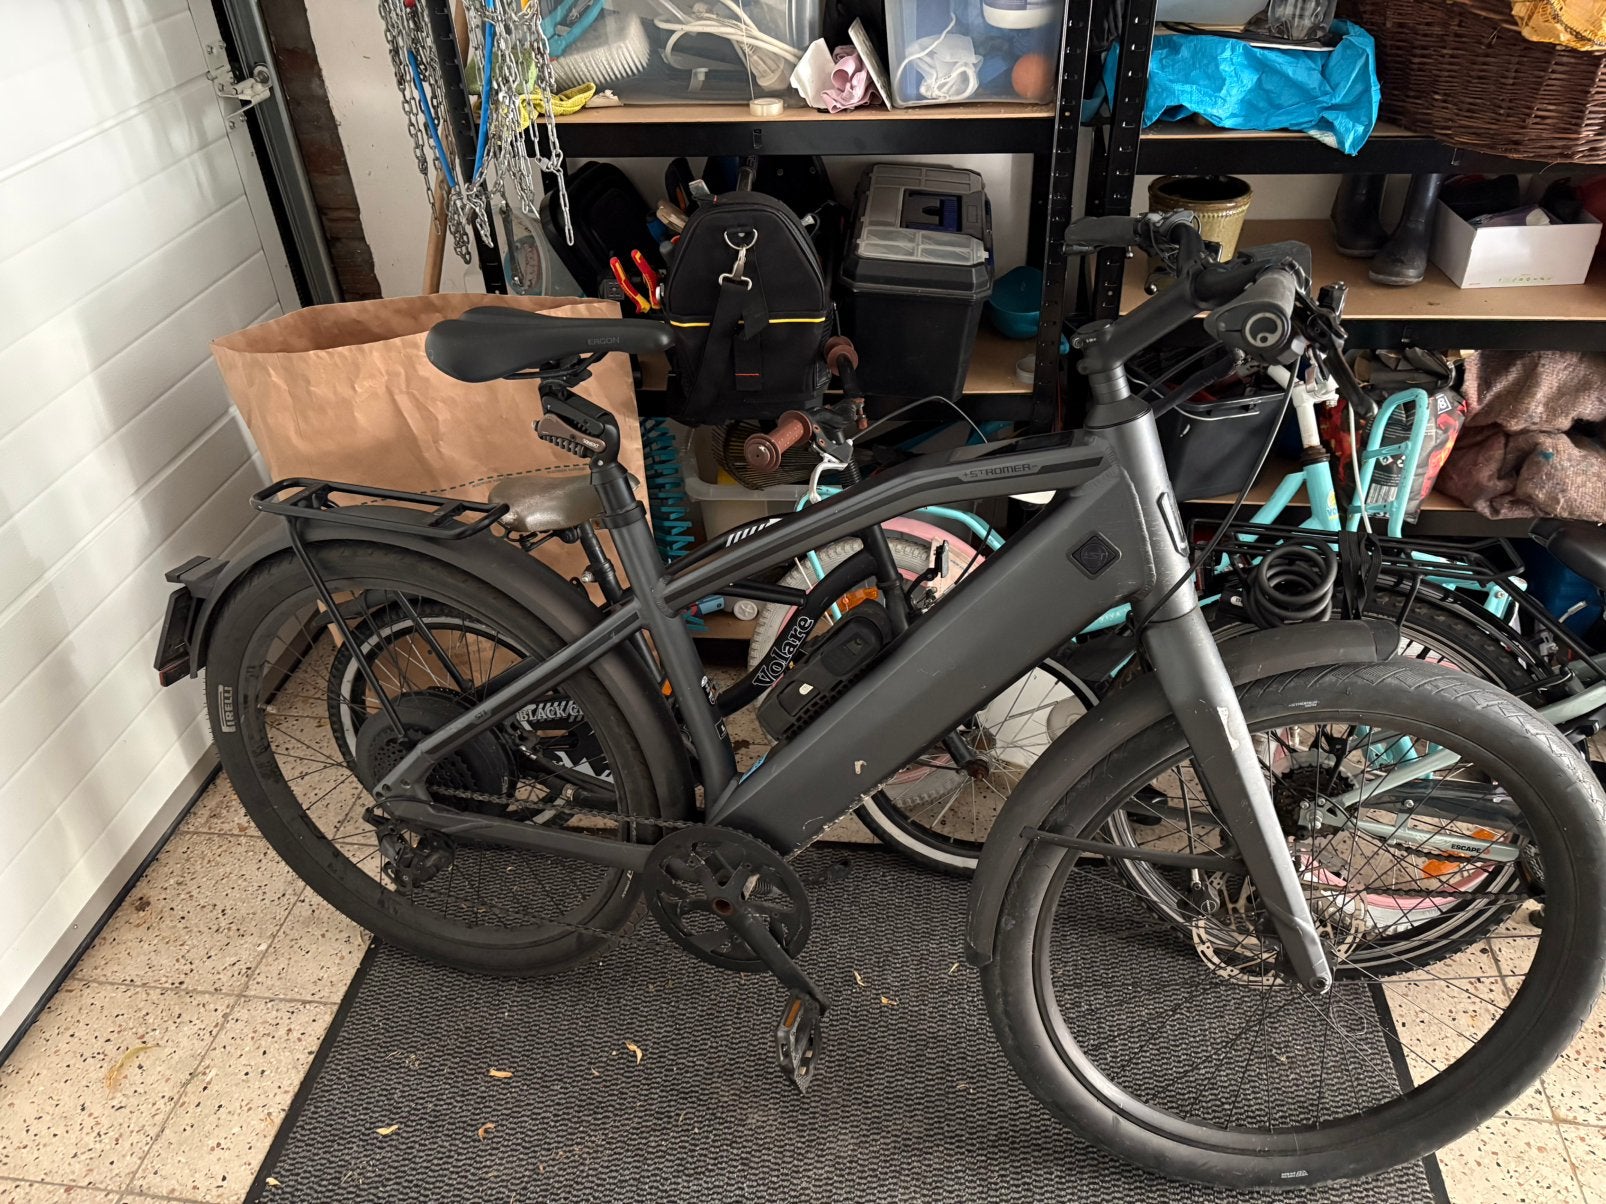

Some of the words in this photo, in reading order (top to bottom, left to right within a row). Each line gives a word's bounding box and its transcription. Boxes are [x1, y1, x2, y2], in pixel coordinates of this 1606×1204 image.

[587, 335, 621, 346] ERGON
[752, 616, 815, 687] Volare
[218, 684, 237, 733] PIRELLI
[517, 705, 568, 721] BLACK
[1450, 843, 1483, 854] ESCAPE
